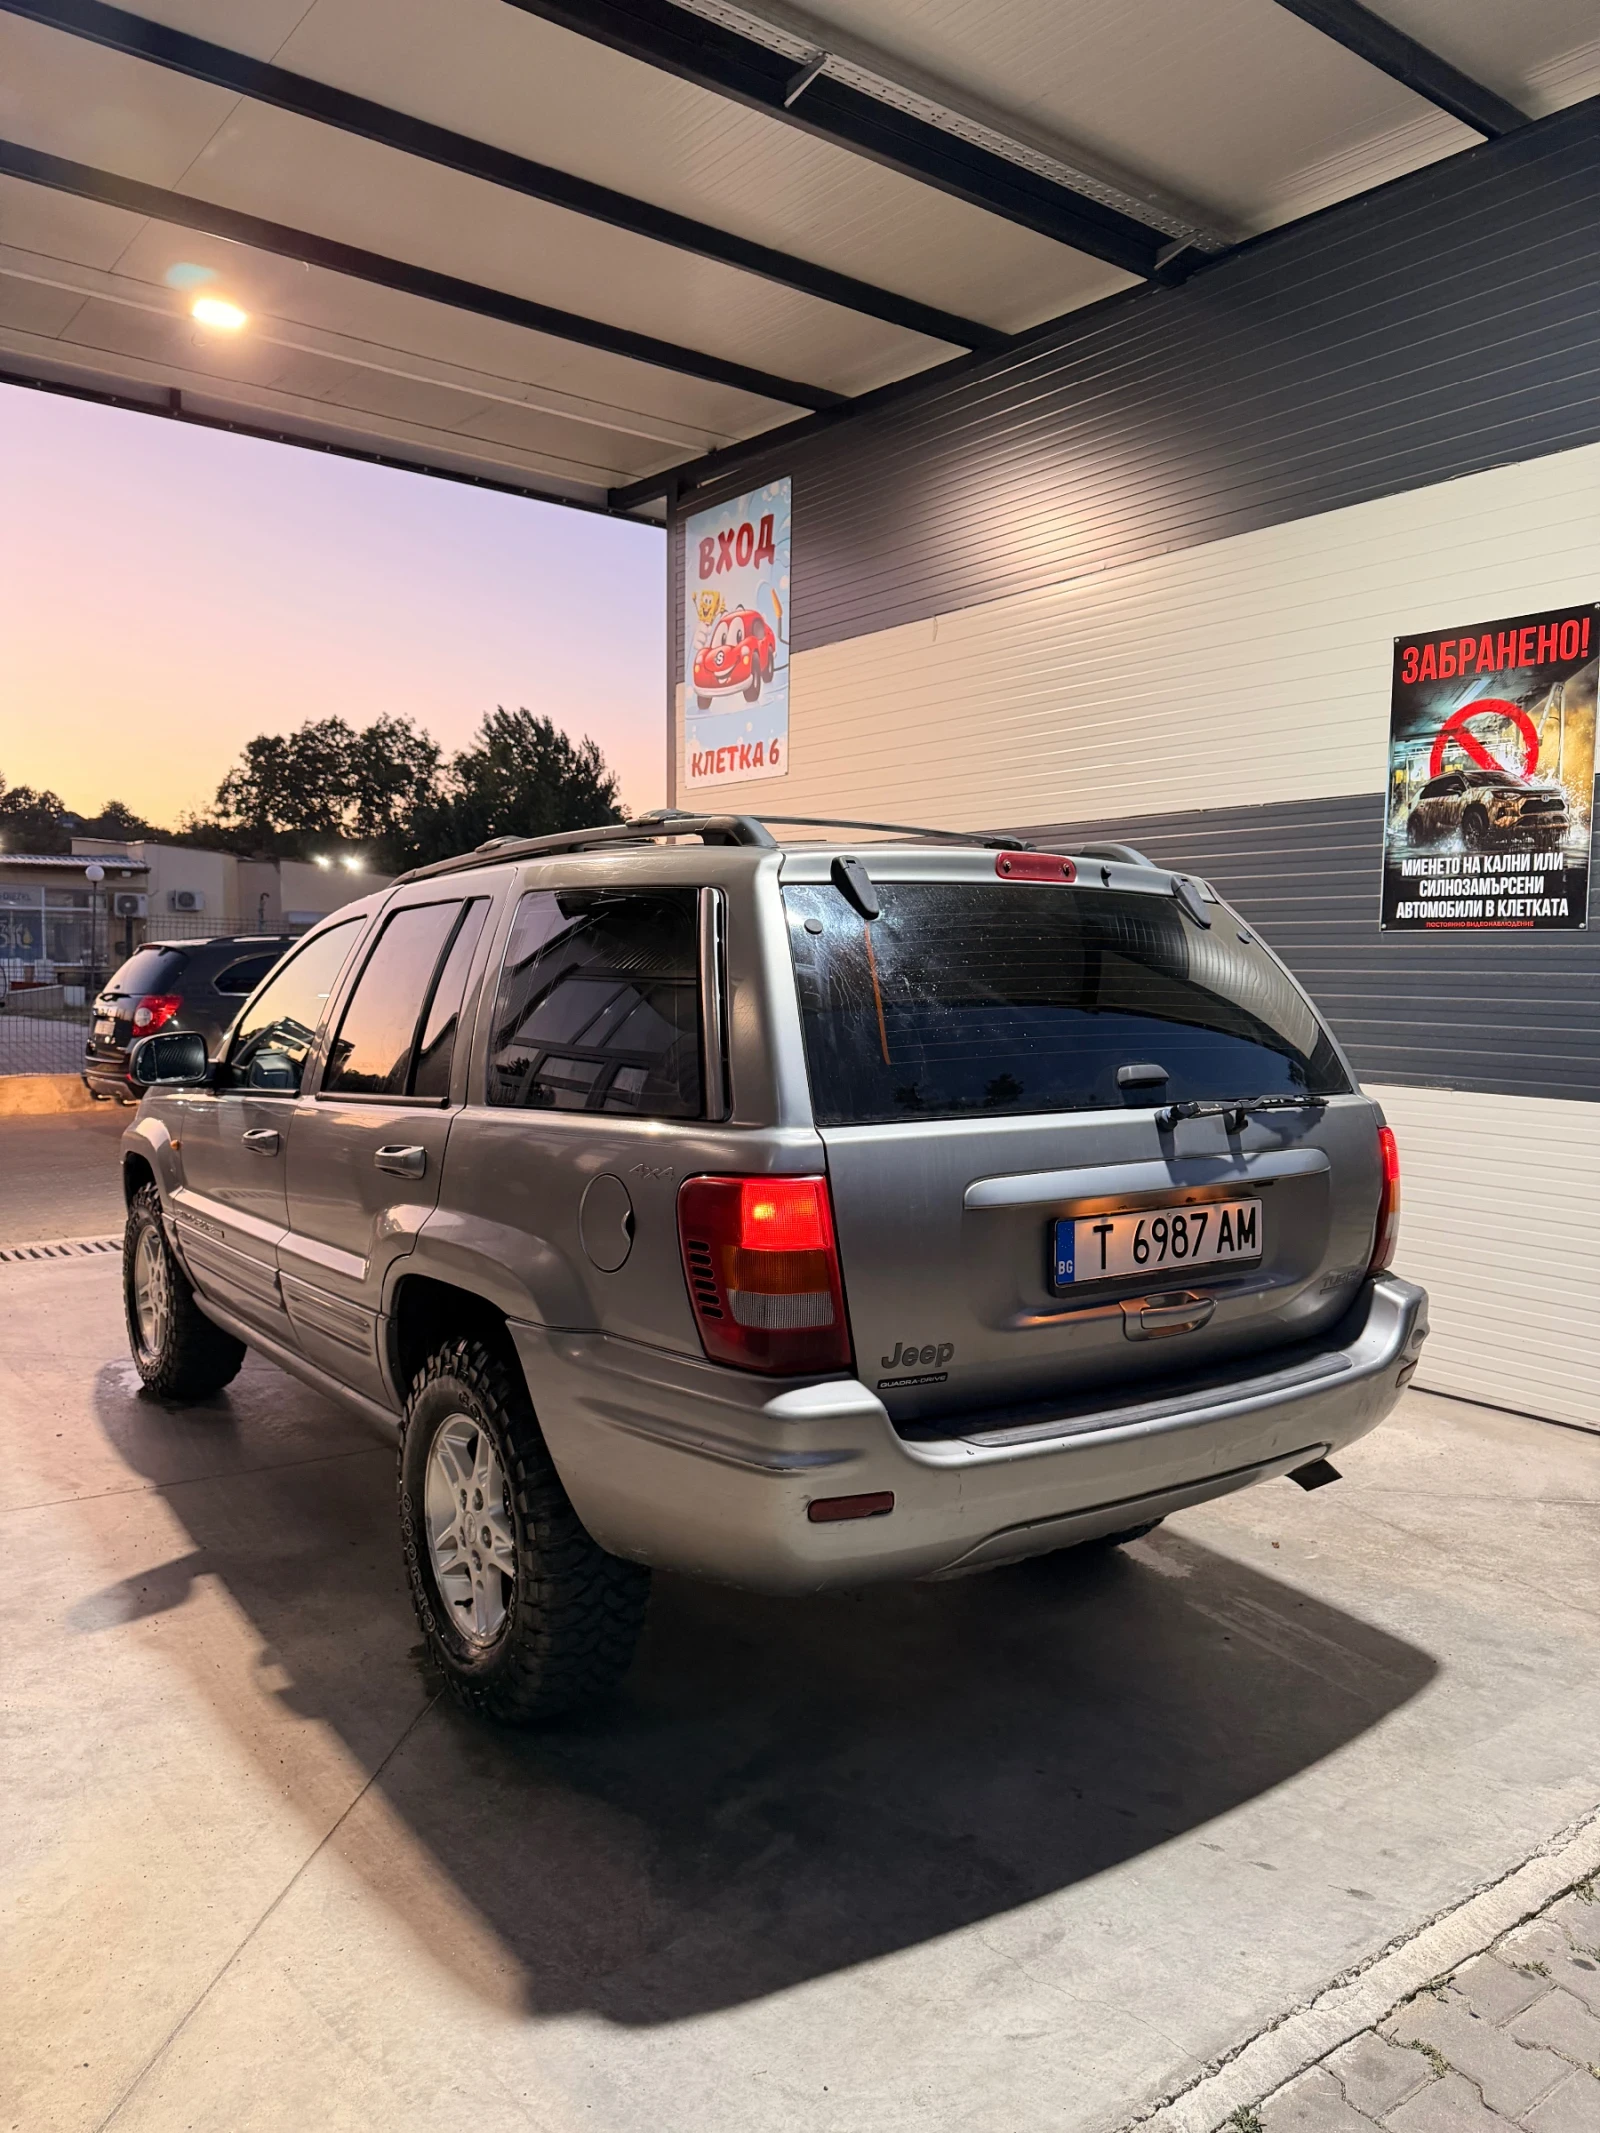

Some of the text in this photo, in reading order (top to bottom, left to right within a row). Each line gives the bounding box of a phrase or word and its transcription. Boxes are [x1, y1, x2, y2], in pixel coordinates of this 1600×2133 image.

[698, 514, 775, 580] ВХОД
[1402, 617, 1590, 684] ЗАБРАНЕНО!
[692, 738, 780, 778] КЛЕТКА 6
[1401, 852, 1564, 877] МИЕНЕТО НА КАЛНИ ИЛИ
[1419, 876, 1545, 897] СИЛНОЗАМЪРСЕНИ
[1396, 898, 1569, 919] АВТОМОБИЛИ В КЛЕТКАТА
[1093, 1207, 1256, 1270] T 6987 AM
[1058, 1260, 1073, 1275] BG
[881, 1342, 954, 1369] Jeep
